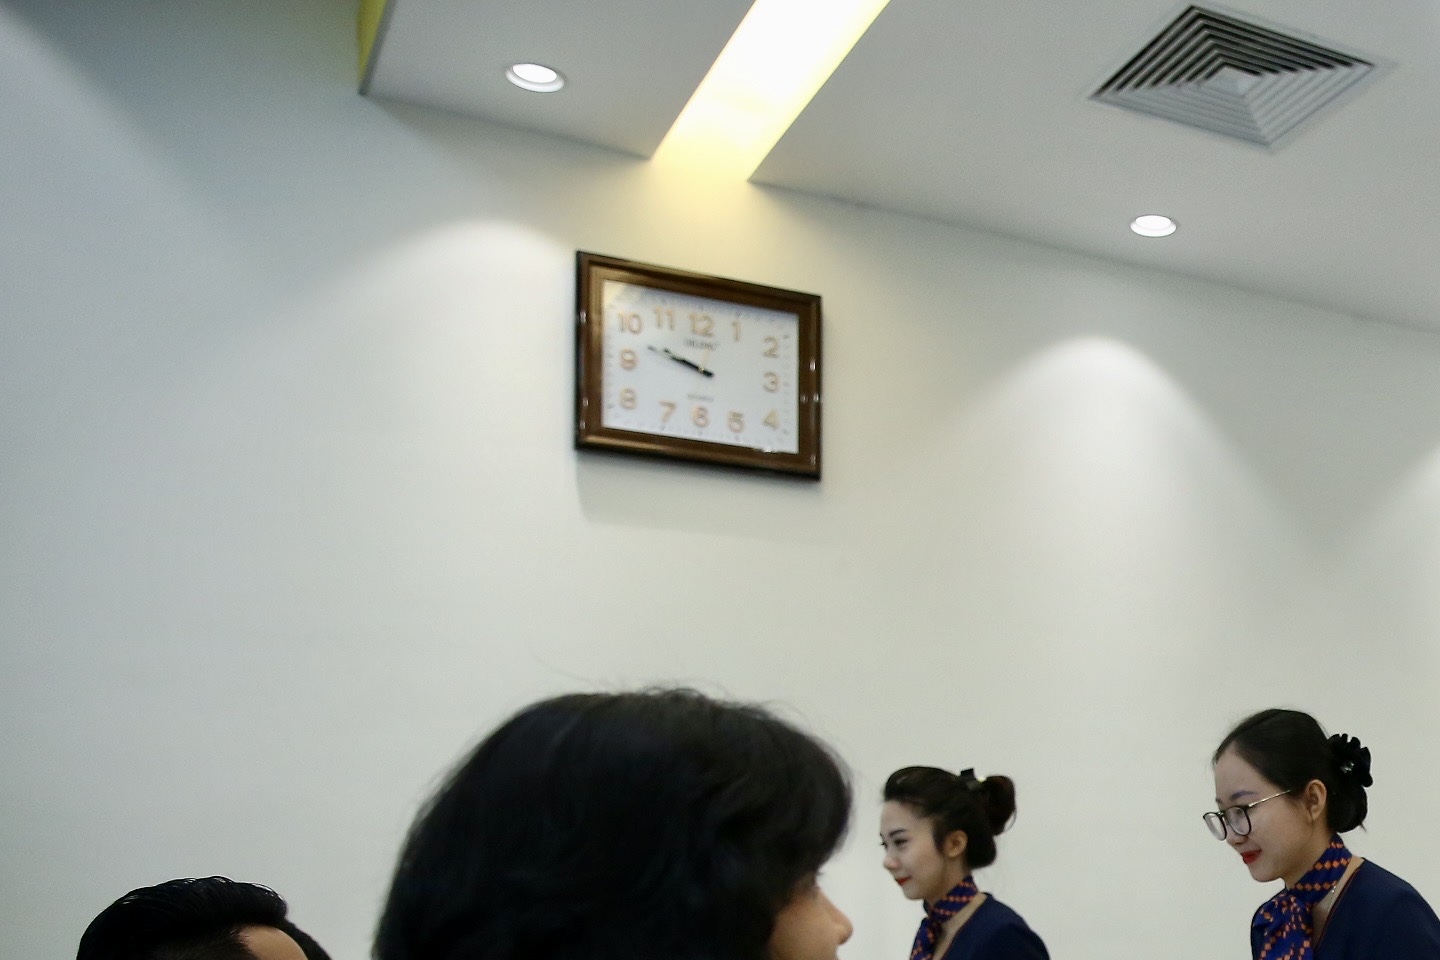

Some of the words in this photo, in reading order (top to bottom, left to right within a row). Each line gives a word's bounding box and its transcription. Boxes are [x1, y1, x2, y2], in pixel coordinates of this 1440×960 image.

[617, 312, 644, 335] 10
[653, 306, 675, 331] 11
[689, 313, 714, 338] 12
[731, 320, 742, 342] 1
[763, 336, 779, 359] 2
[619, 349, 637, 371] 9
[763, 371, 780, 394] 3
[620, 387, 637, 411] 8
[659, 401, 676, 425] 7
[692, 406, 710, 429] 6
[728, 411, 745, 434] 5
[763, 409, 780, 431] 4
